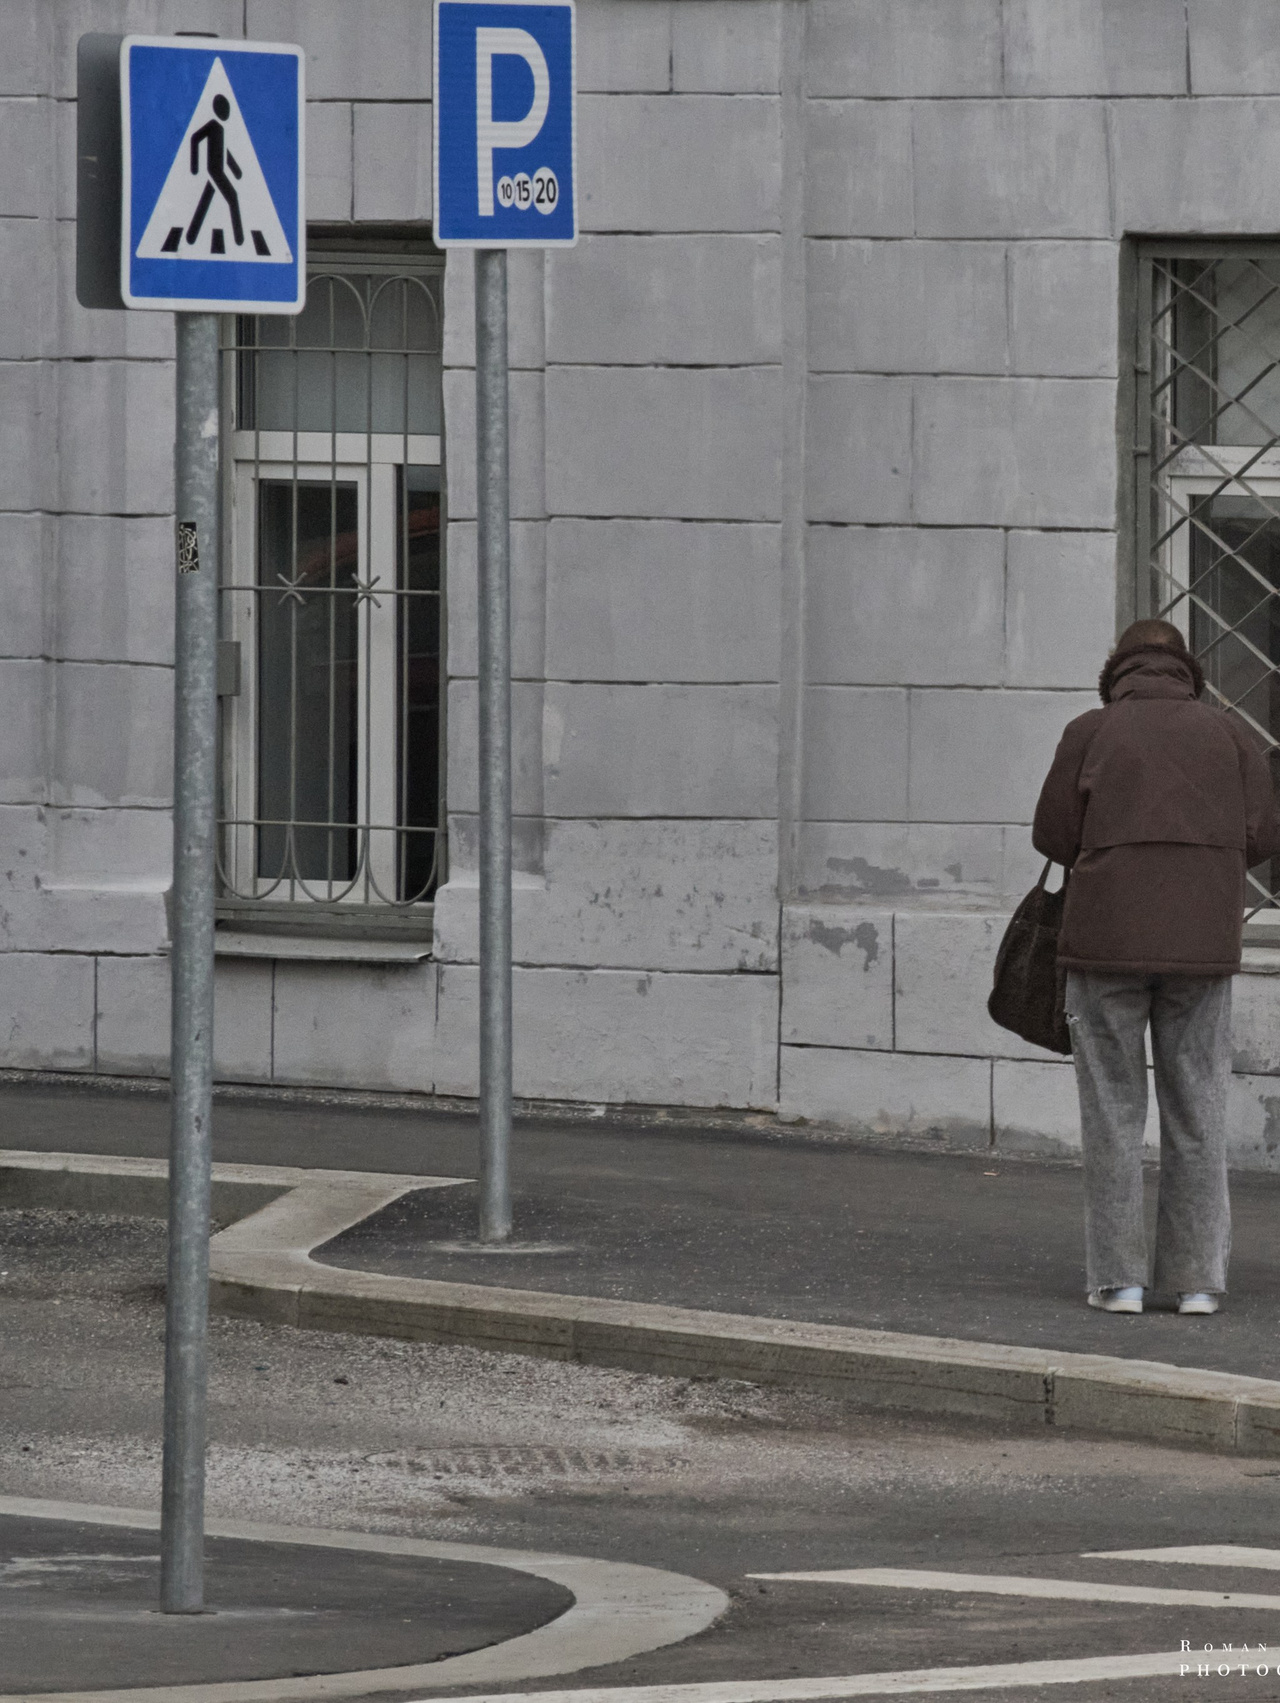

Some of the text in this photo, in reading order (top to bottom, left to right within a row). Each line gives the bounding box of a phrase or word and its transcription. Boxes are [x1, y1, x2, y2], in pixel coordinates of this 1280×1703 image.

[475, 27, 550, 216] P
[501, 177, 557, 204] 10 15 20
